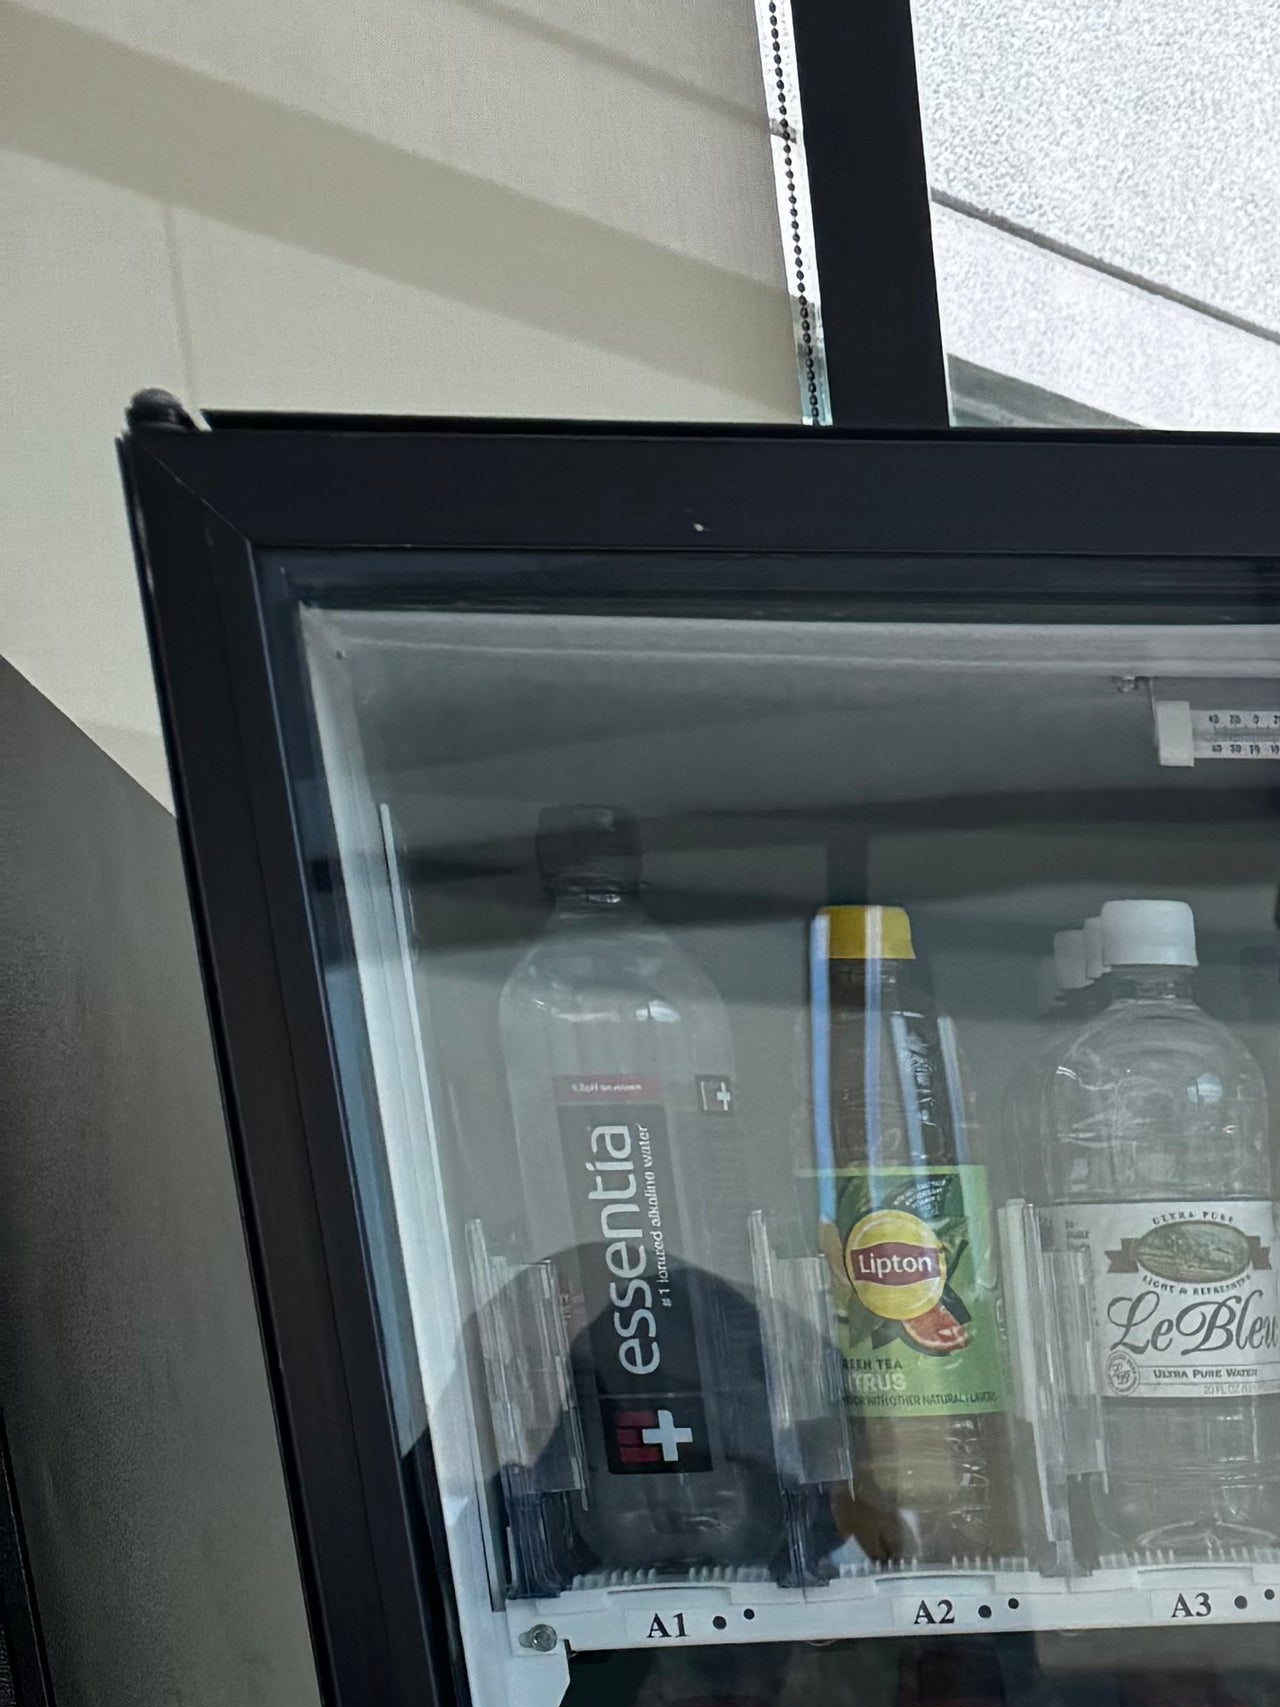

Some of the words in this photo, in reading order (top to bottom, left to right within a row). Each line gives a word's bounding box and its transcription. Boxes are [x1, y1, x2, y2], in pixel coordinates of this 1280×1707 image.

[585, 1124, 660, 1374] essentia
[859, 1253, 932, 1278] Lipton
[877, 1358, 903, 1370] TEA
[1153, 1369, 1188, 1379] ULTRA
[1192, 1369, 1222, 1378] PURE
[1226, 1368, 1257, 1378] WATER
[913, 1599, 956, 1625] A2
[1170, 1591, 1212, 1618] A3
[647, 1613, 687, 1640] A1
